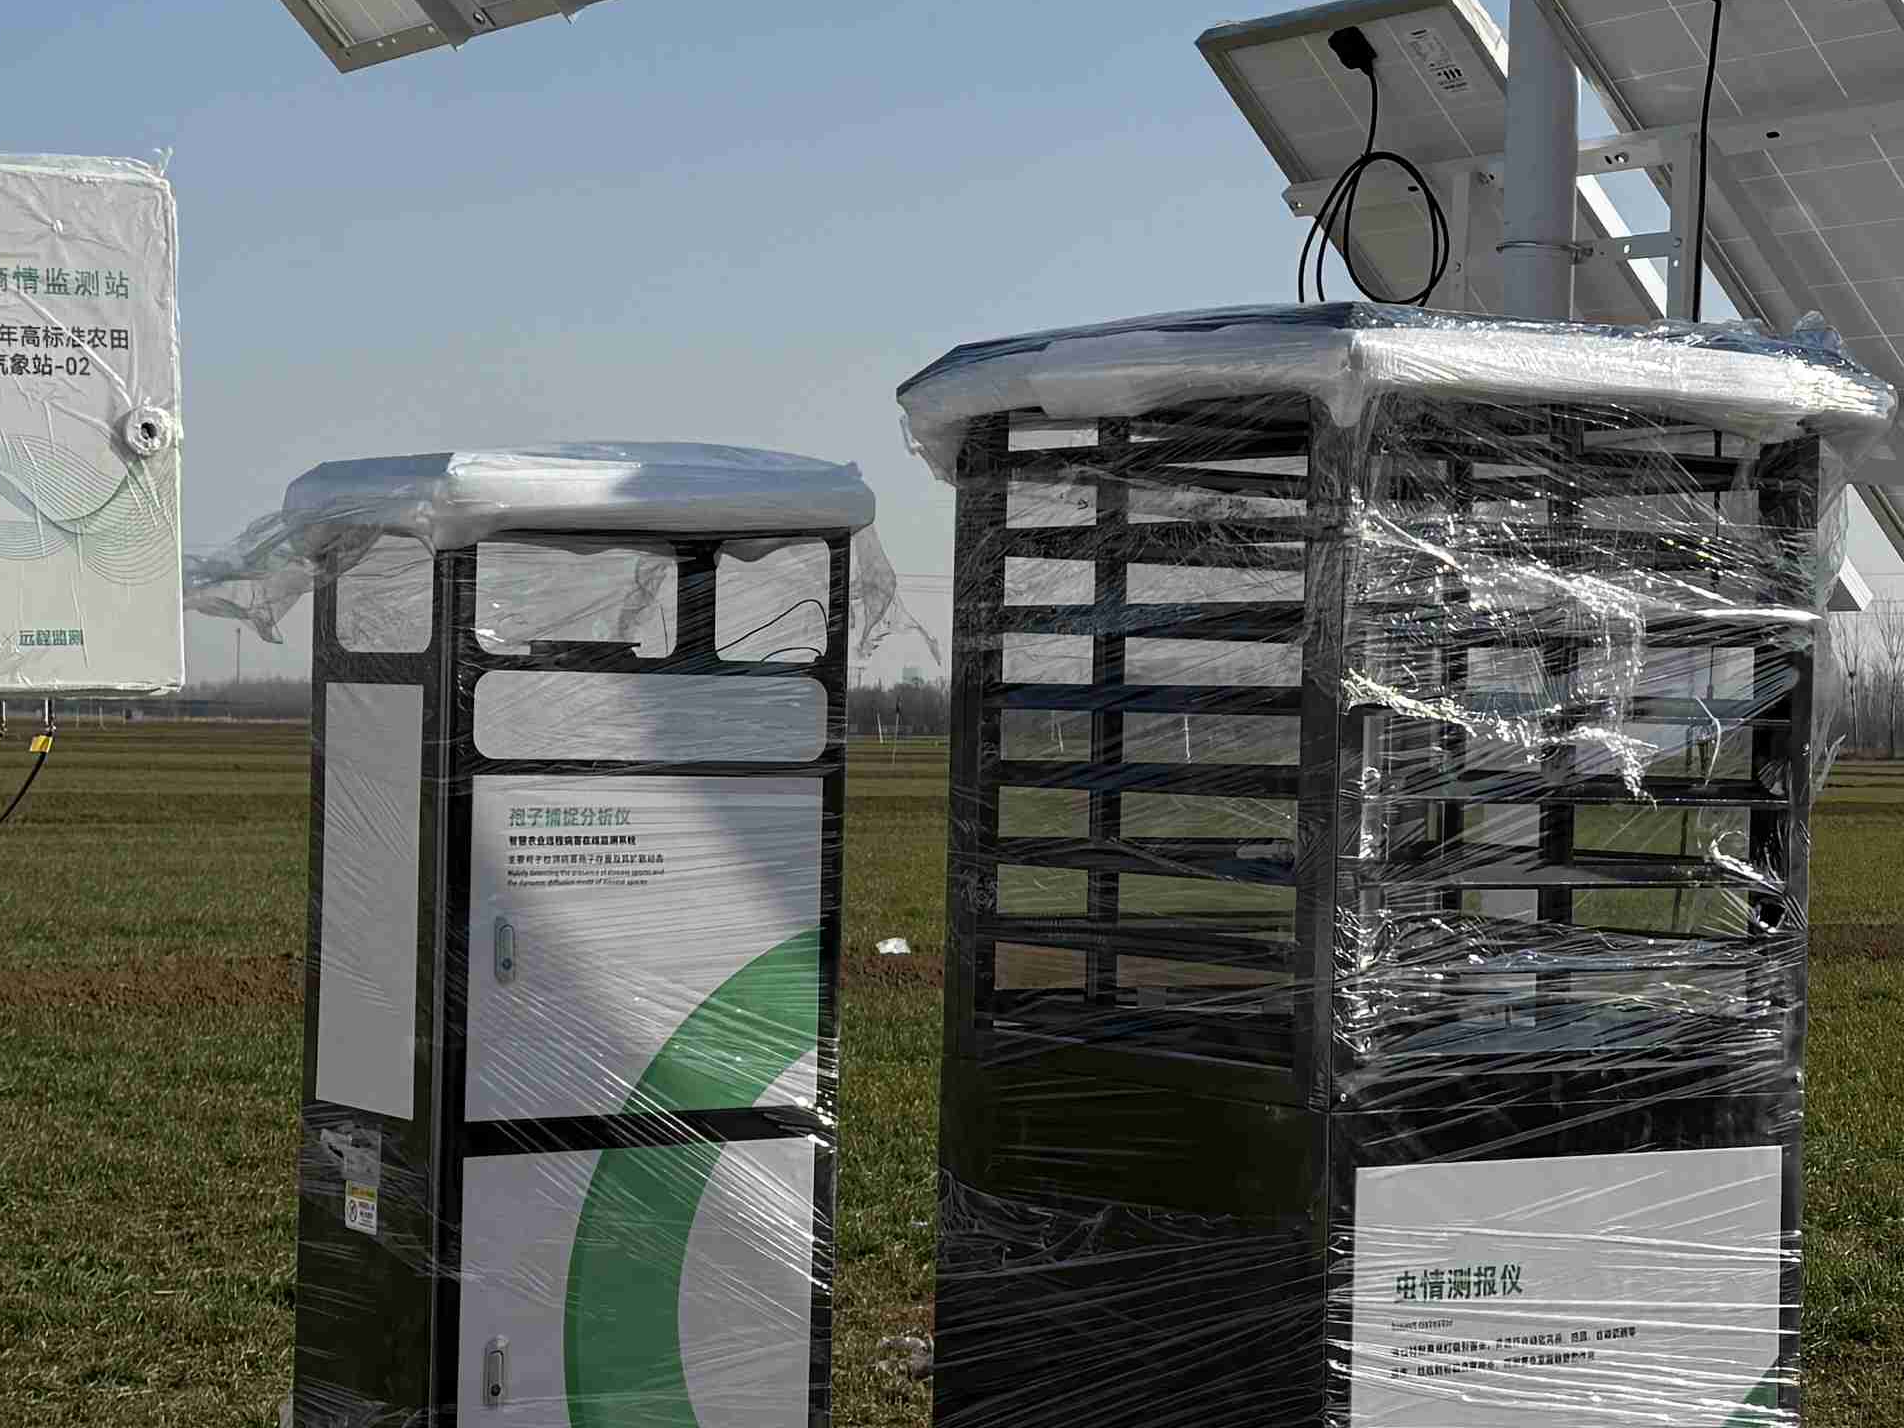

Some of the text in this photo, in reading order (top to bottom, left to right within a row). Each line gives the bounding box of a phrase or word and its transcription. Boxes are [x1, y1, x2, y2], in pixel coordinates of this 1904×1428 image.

[1393, 1262, 1524, 1303] 虫情测报仪
